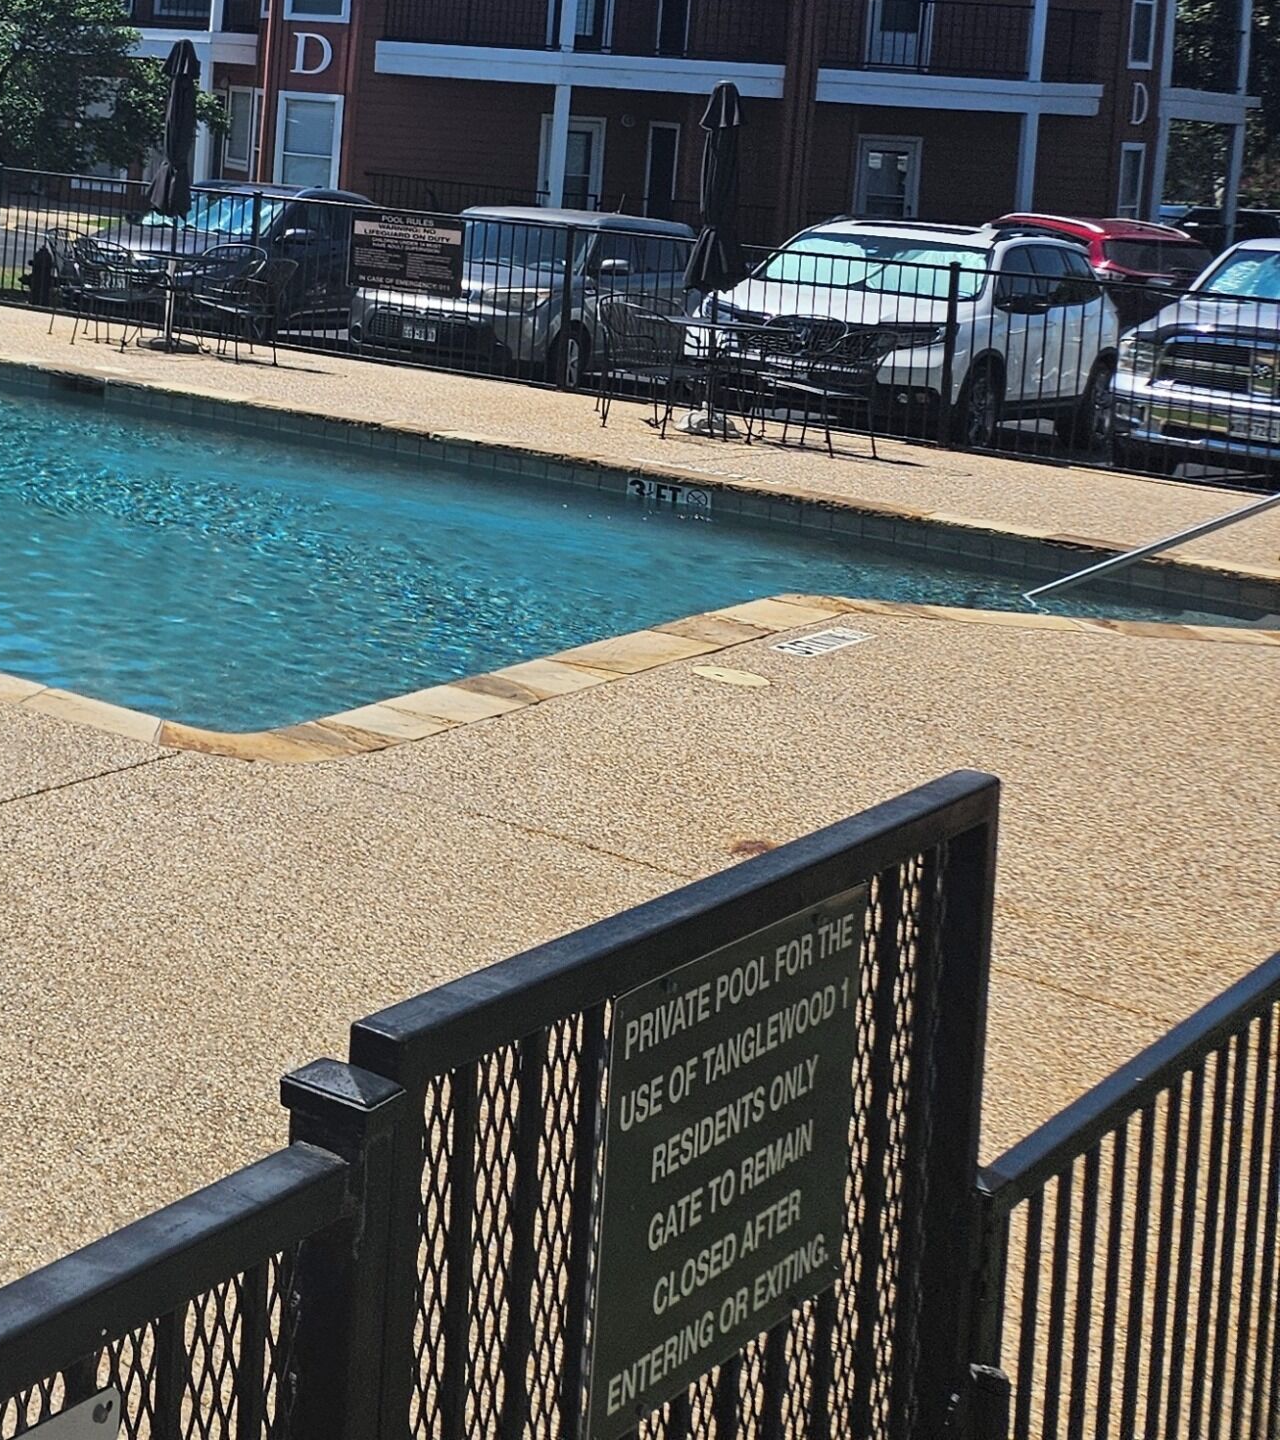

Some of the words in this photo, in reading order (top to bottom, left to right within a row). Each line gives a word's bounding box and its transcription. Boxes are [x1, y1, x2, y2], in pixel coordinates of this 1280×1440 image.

[290, 32, 333, 75] D
[1130, 82, 1149, 125] D
[364, 229, 410, 239] LIFEGUARD
[412, 233, 426, 241] ON
[428, 234, 450, 243] DUTY
[382, 215, 404, 224] POOL
[406, 217, 434, 227] RULES
[423, 228, 436, 236] NO
[367, 275, 384, 283] CASE
[625, 982, 711, 1060] PRIVATE
[716, 956, 770, 1012] POOL
[775, 933, 813, 982] FOR
[818, 913, 854, 959] THE
[620, 1075, 664, 1132] USE
[669, 1056, 698, 1103] OF
[702, 984, 836, 1085] TANGLEWOOD
[841, 976, 849, 1009] 1
[651, 1085, 766, 1183] RESIDENTS
[769, 1054, 819, 1111] ONLY
[648, 1187, 703, 1251] GATE
[708, 1168, 736, 1213] TO
[740, 1119, 814, 1195] REMAIN
[653, 1232, 736, 1315] CLOSED
[740, 1188, 802, 1258] AFTER
[607, 1310, 715, 1416] ENTERING
[719, 1286, 748, 1334] OR
[753, 1233, 828, 1312] EXITING.
